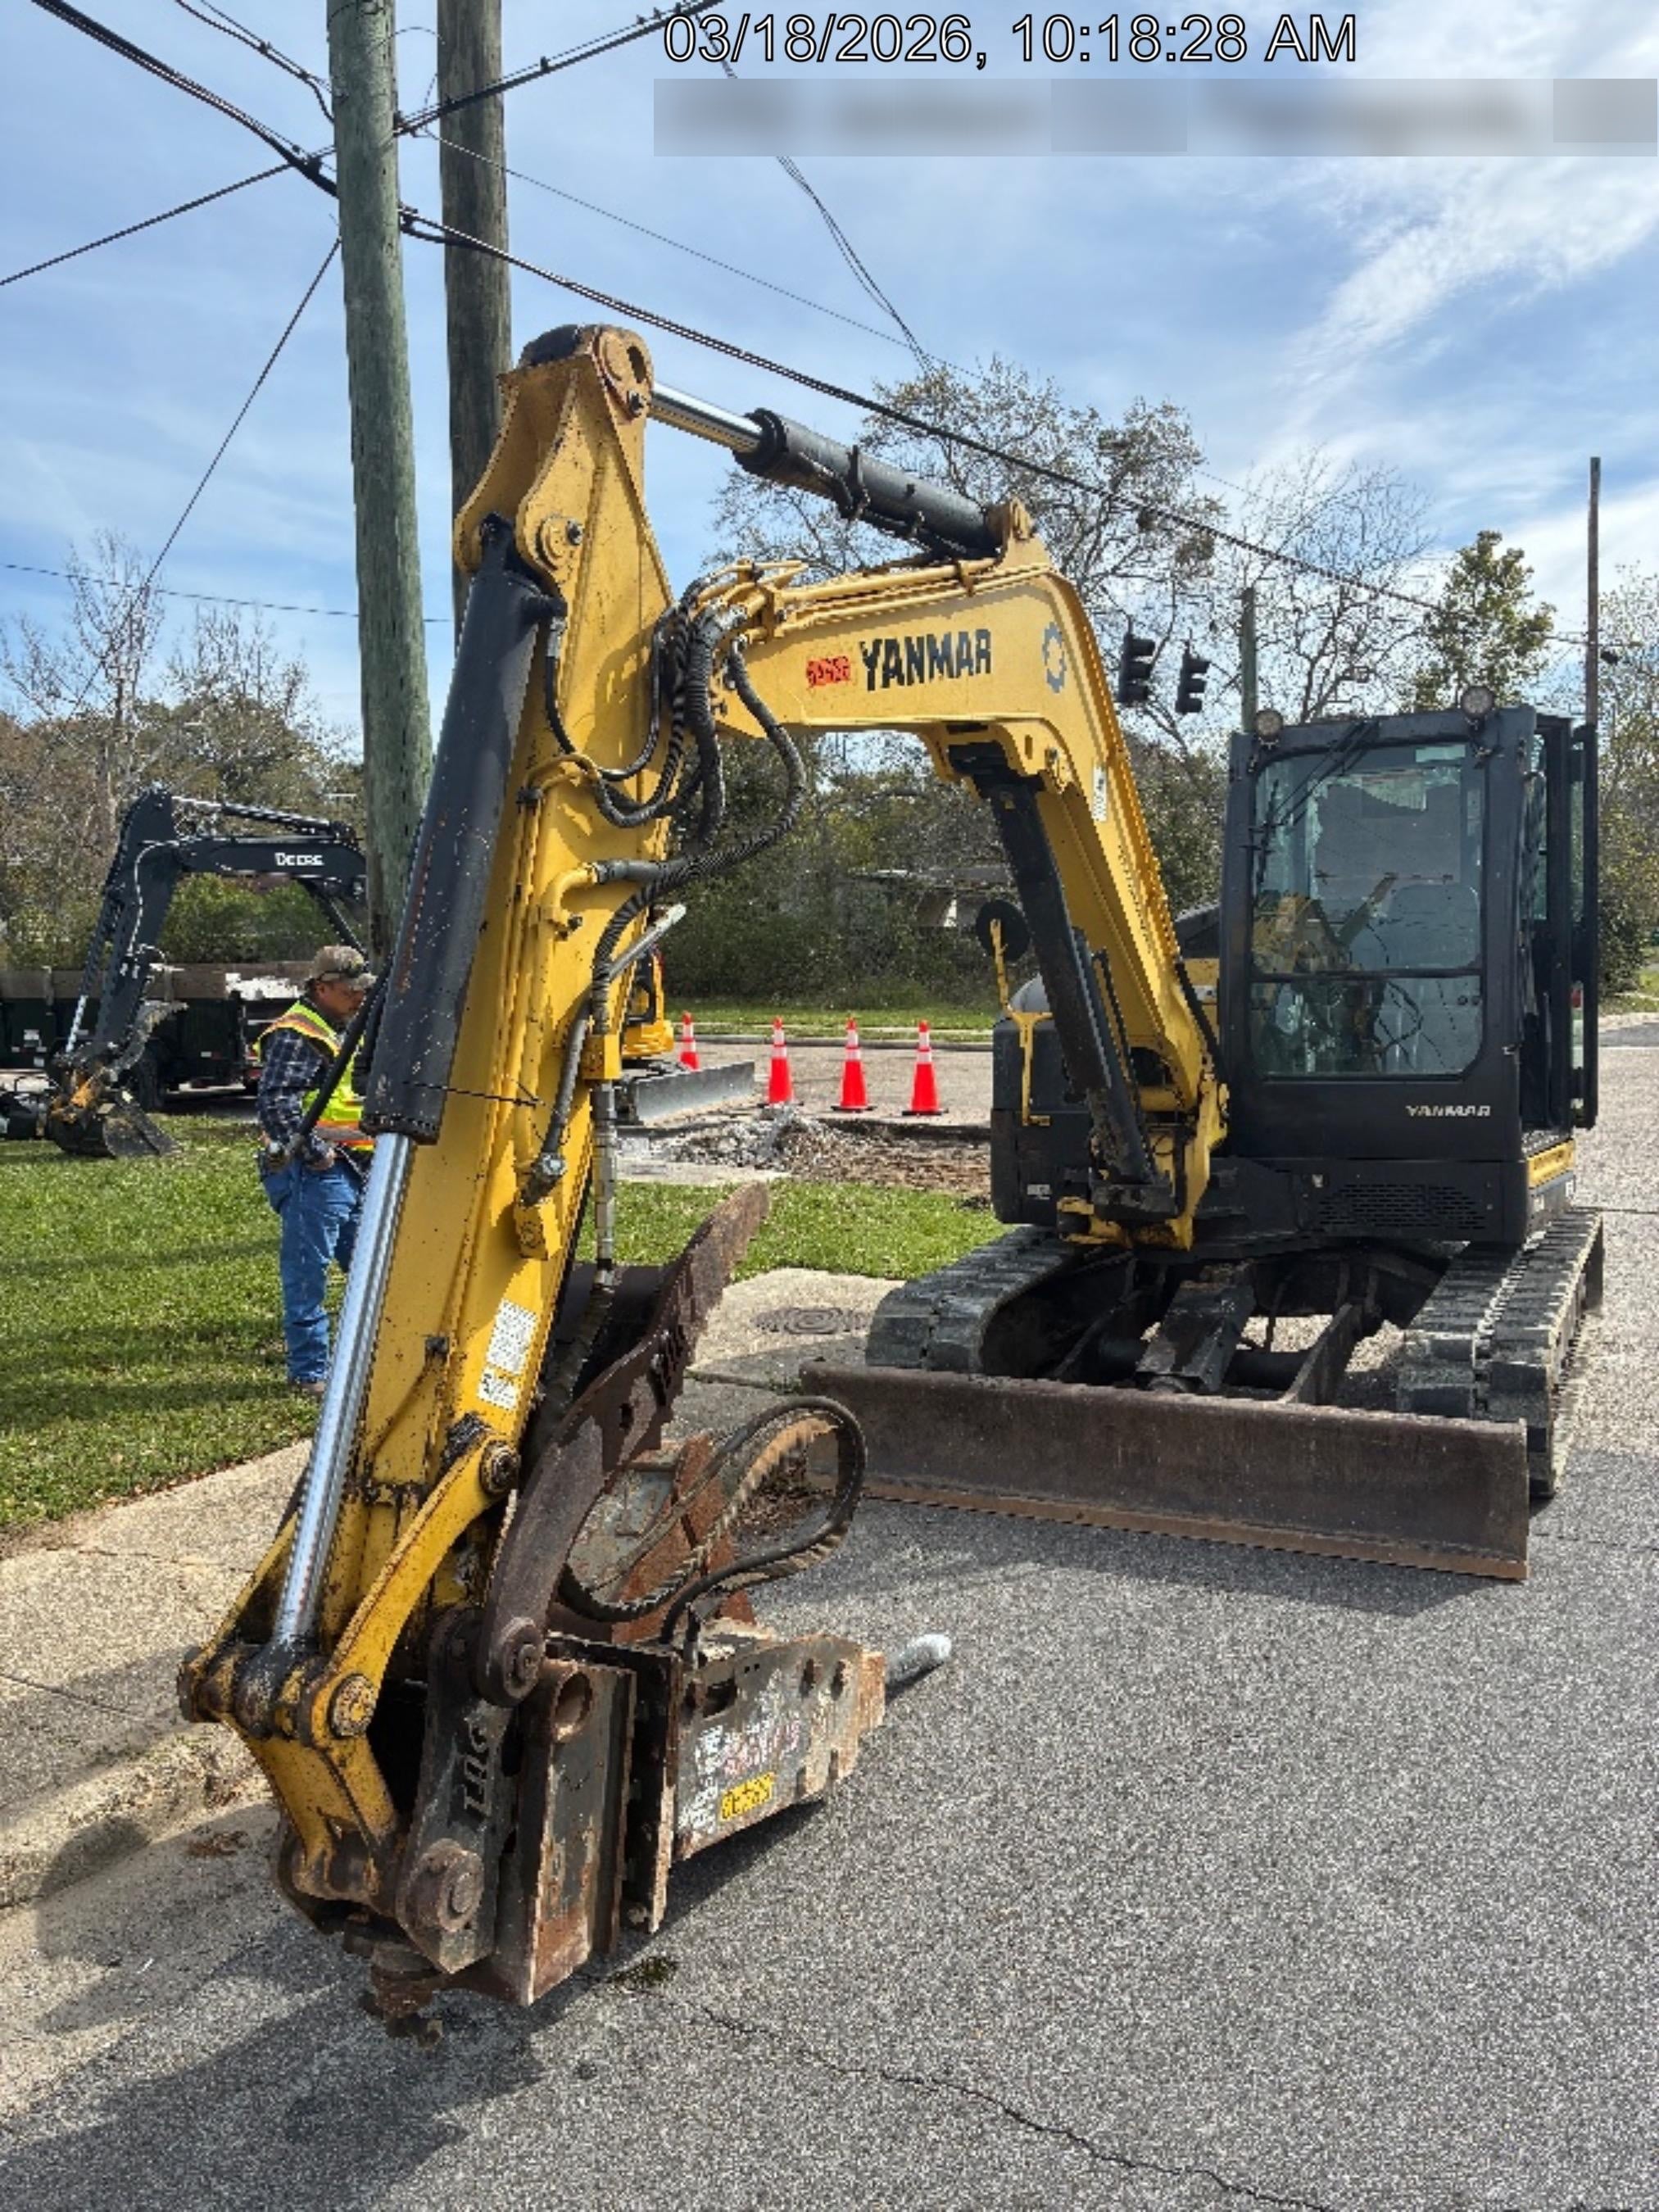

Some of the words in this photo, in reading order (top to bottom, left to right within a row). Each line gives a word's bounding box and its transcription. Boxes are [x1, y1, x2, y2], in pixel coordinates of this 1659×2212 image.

[859, 628, 991, 691] YANMAR
[274, 852, 324, 866] DEERE
[1405, 1105, 1491, 1117] YANMAR
